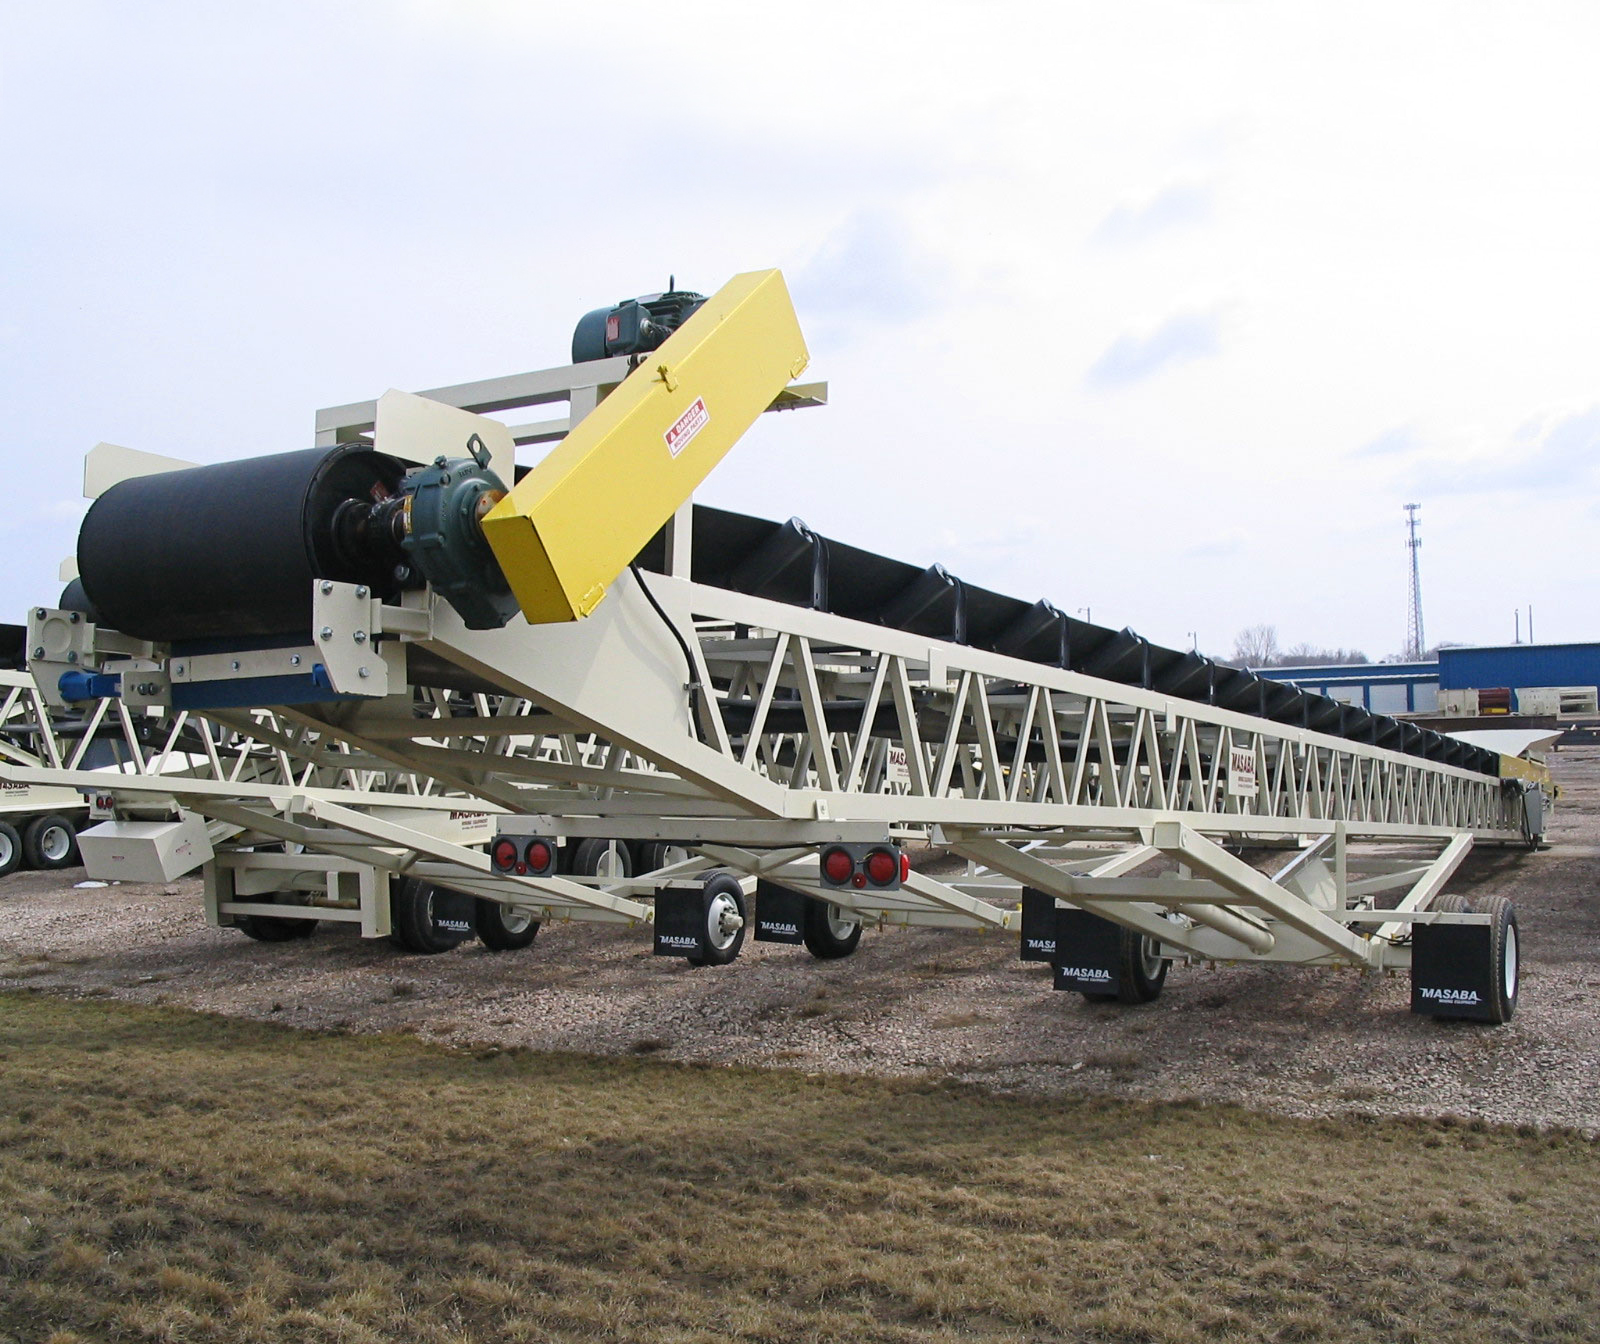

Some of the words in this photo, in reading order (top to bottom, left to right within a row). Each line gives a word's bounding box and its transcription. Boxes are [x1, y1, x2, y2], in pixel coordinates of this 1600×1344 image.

[675, 404, 701, 434] DANGER
[690, 414, 704, 432] PARTS
[889, 750, 907, 765] MAS
[1231, 753, 1255, 774] MASABA
[437, 919, 471, 930] MASABA
[760, 921, 799, 932] MASABA
[659, 935, 699, 946] MASABA
[1061, 967, 1113, 979] MASABA
[1419, 987, 1482, 1001] MASABA
